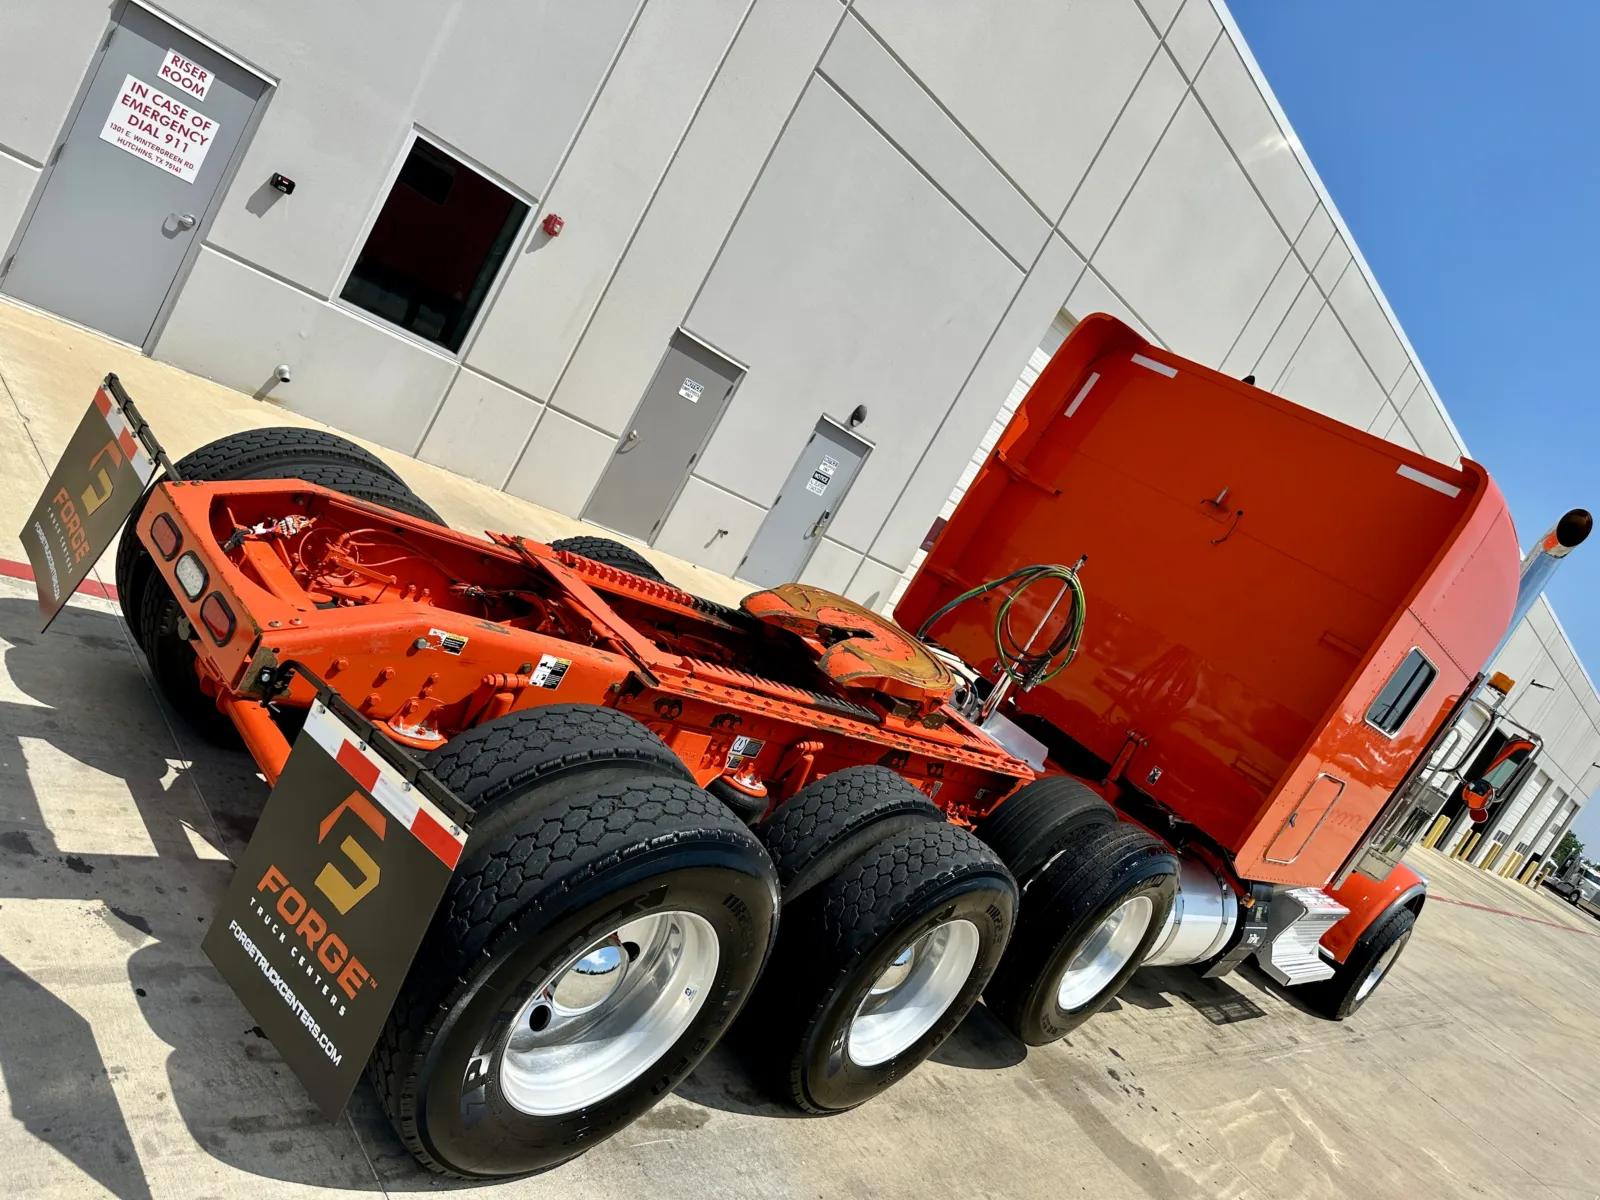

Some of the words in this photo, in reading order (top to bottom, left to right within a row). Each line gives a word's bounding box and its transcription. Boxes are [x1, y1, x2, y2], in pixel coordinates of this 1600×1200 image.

[161, 65, 205, 97] ROOM
[171, 55, 208, 83] RISER
[121, 94, 209, 146] EMERGENCY
[130, 82, 149, 98] IN
[152, 94, 189, 120] CASE
[191, 116, 212, 132] OF
[110, 122, 124, 134] 1301
[133, 135, 184, 164] WINTERGREEN
[117, 137, 154, 161] HUTCHINS,
[155, 155, 164, 164] TX
[165, 160, 182, 174] 75141
[127, 114, 160, 139] DIAL
[165, 133, 189, 153] 911
[53, 487, 91, 564] FORGE
[250, 897, 286, 944] TRUCK
[290, 946, 346, 1017] CENTERS
[256, 864, 370, 1000] FORGE
[228, 919, 343, 1067] FORGETRUCKCENTERS.COM
